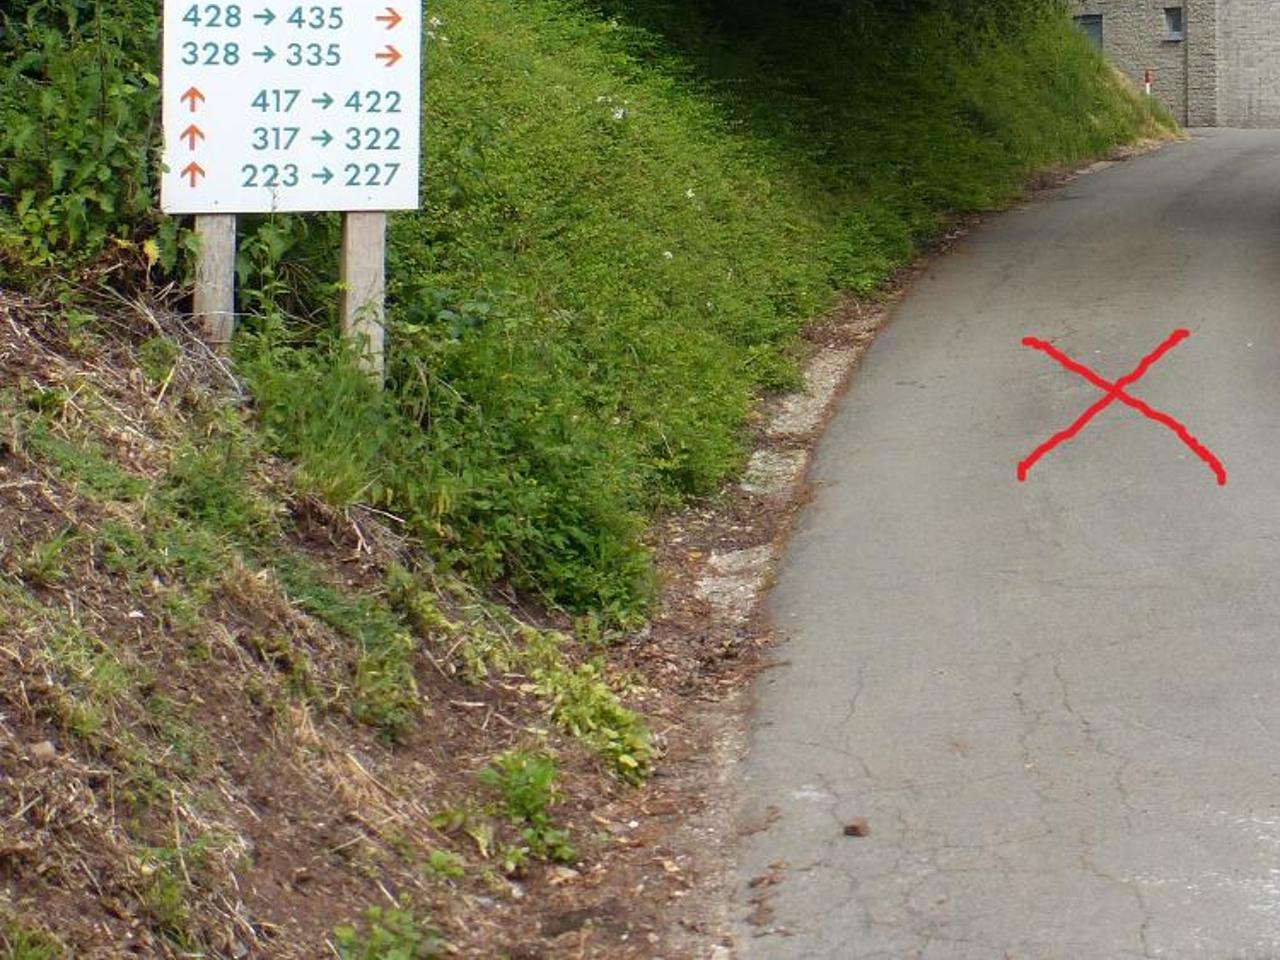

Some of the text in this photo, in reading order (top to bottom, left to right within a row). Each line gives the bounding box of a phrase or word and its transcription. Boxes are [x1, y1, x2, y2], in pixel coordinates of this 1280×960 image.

[182, 4, 343, 29] 428 435
[182, 41, 341, 66] 328 335
[251, 89, 401, 113] 417 422
[252, 127, 400, 150] 317 322
[242, 163, 400, 187] 223 227
